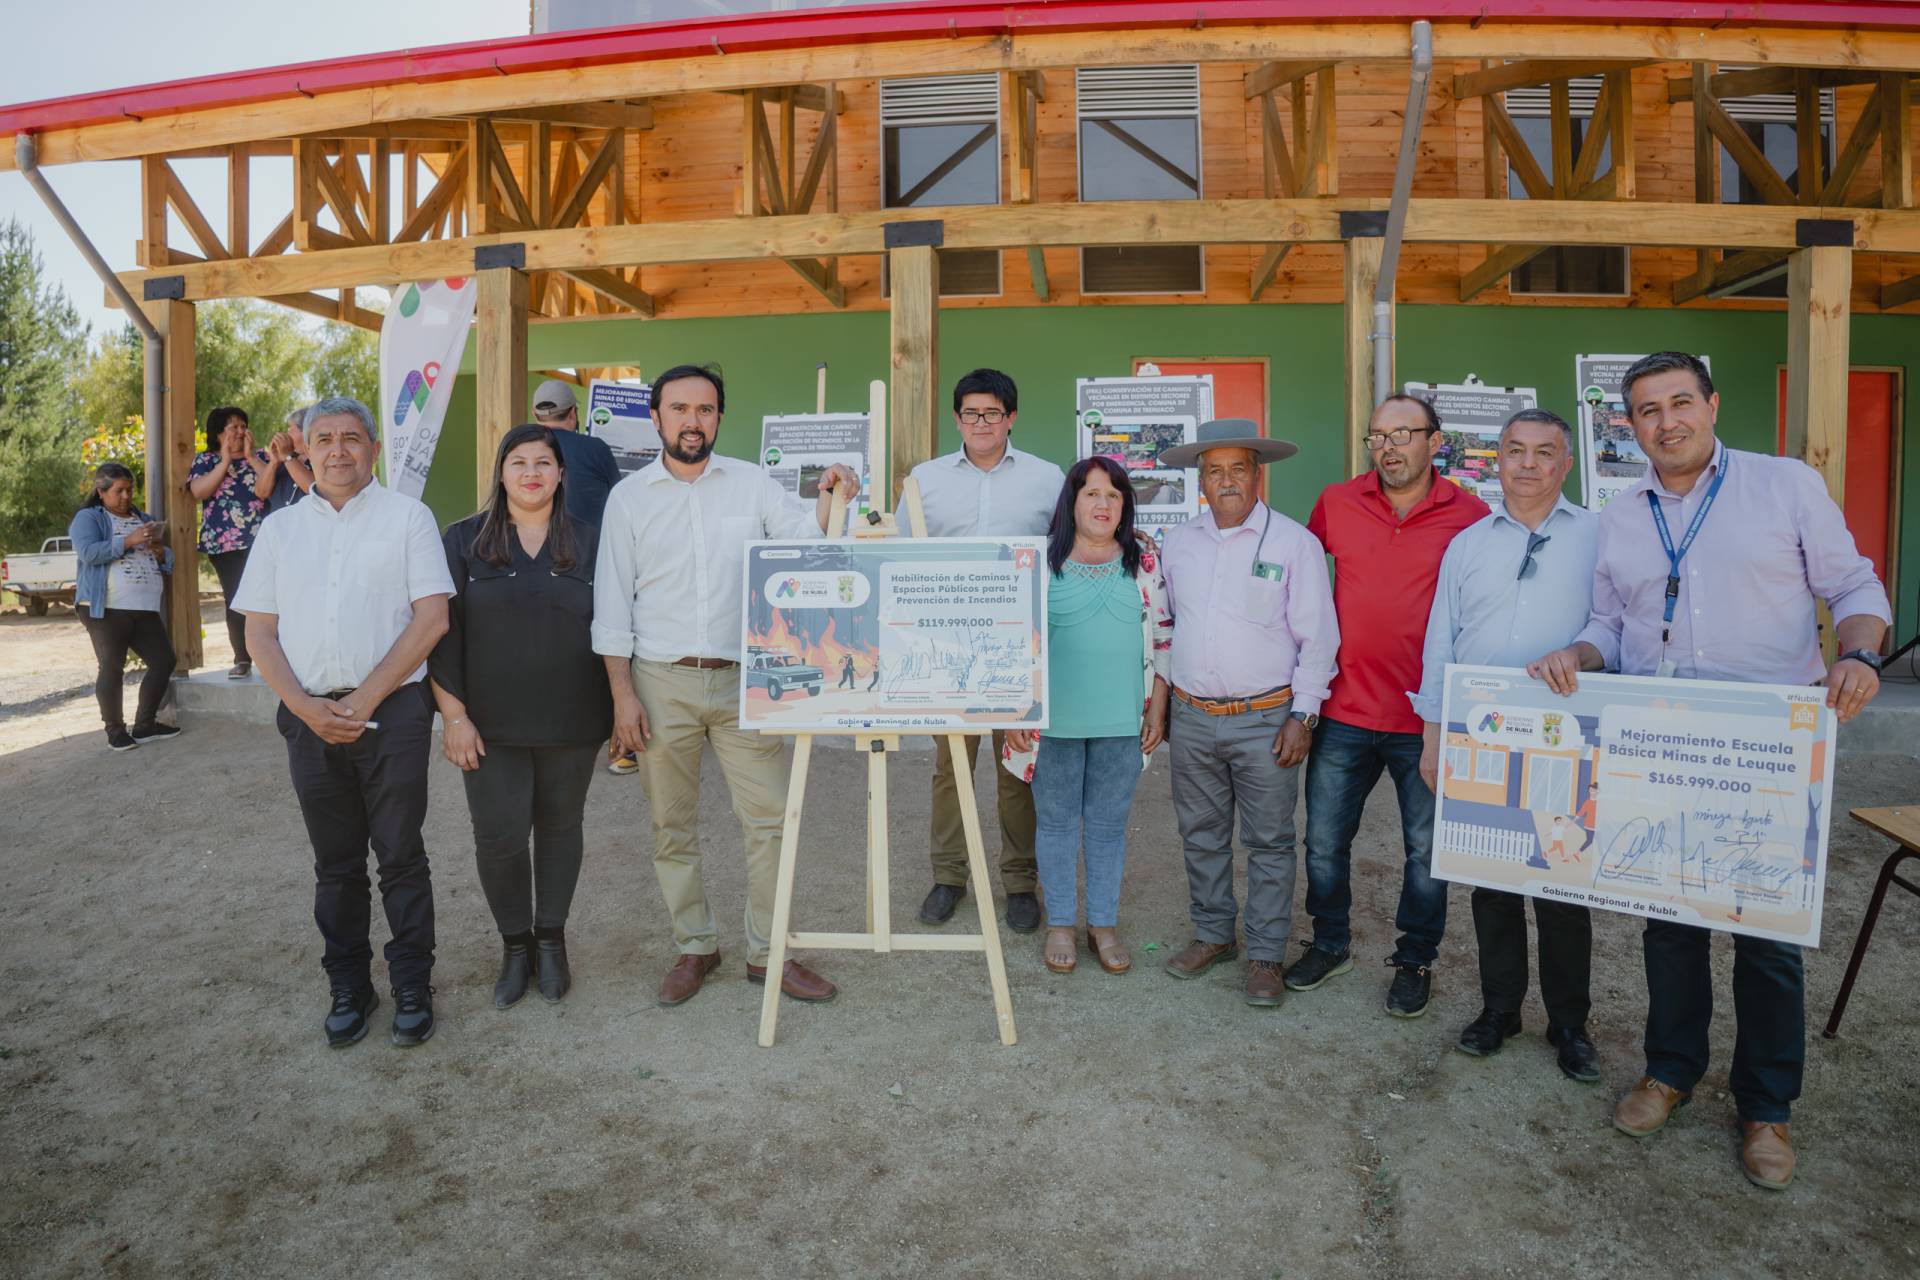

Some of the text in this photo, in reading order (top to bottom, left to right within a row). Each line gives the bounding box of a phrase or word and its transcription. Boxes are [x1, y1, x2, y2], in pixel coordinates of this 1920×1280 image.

[596, 388, 643, 398] MEJORAMIENTO
[891, 572, 1020, 583] Habilitación de Caminos y
[892, 584, 1018, 595] Espacios Públicos para la
[896, 595, 1017, 605] Prevención de Incendios
[918, 618, 994, 628] $119.999.000
[1470, 679, 1500, 688] Convenio
[924, 716, 947, 725] Ñuble
[1620, 728, 1794, 755] Mejoramiento Escuela
[1608, 744, 1796, 774] Básica Minas de Leuque
[1648, 771, 1752, 794] $165.999.000
[1542, 886, 1678, 917] Gobierno Regional de Ñuble
